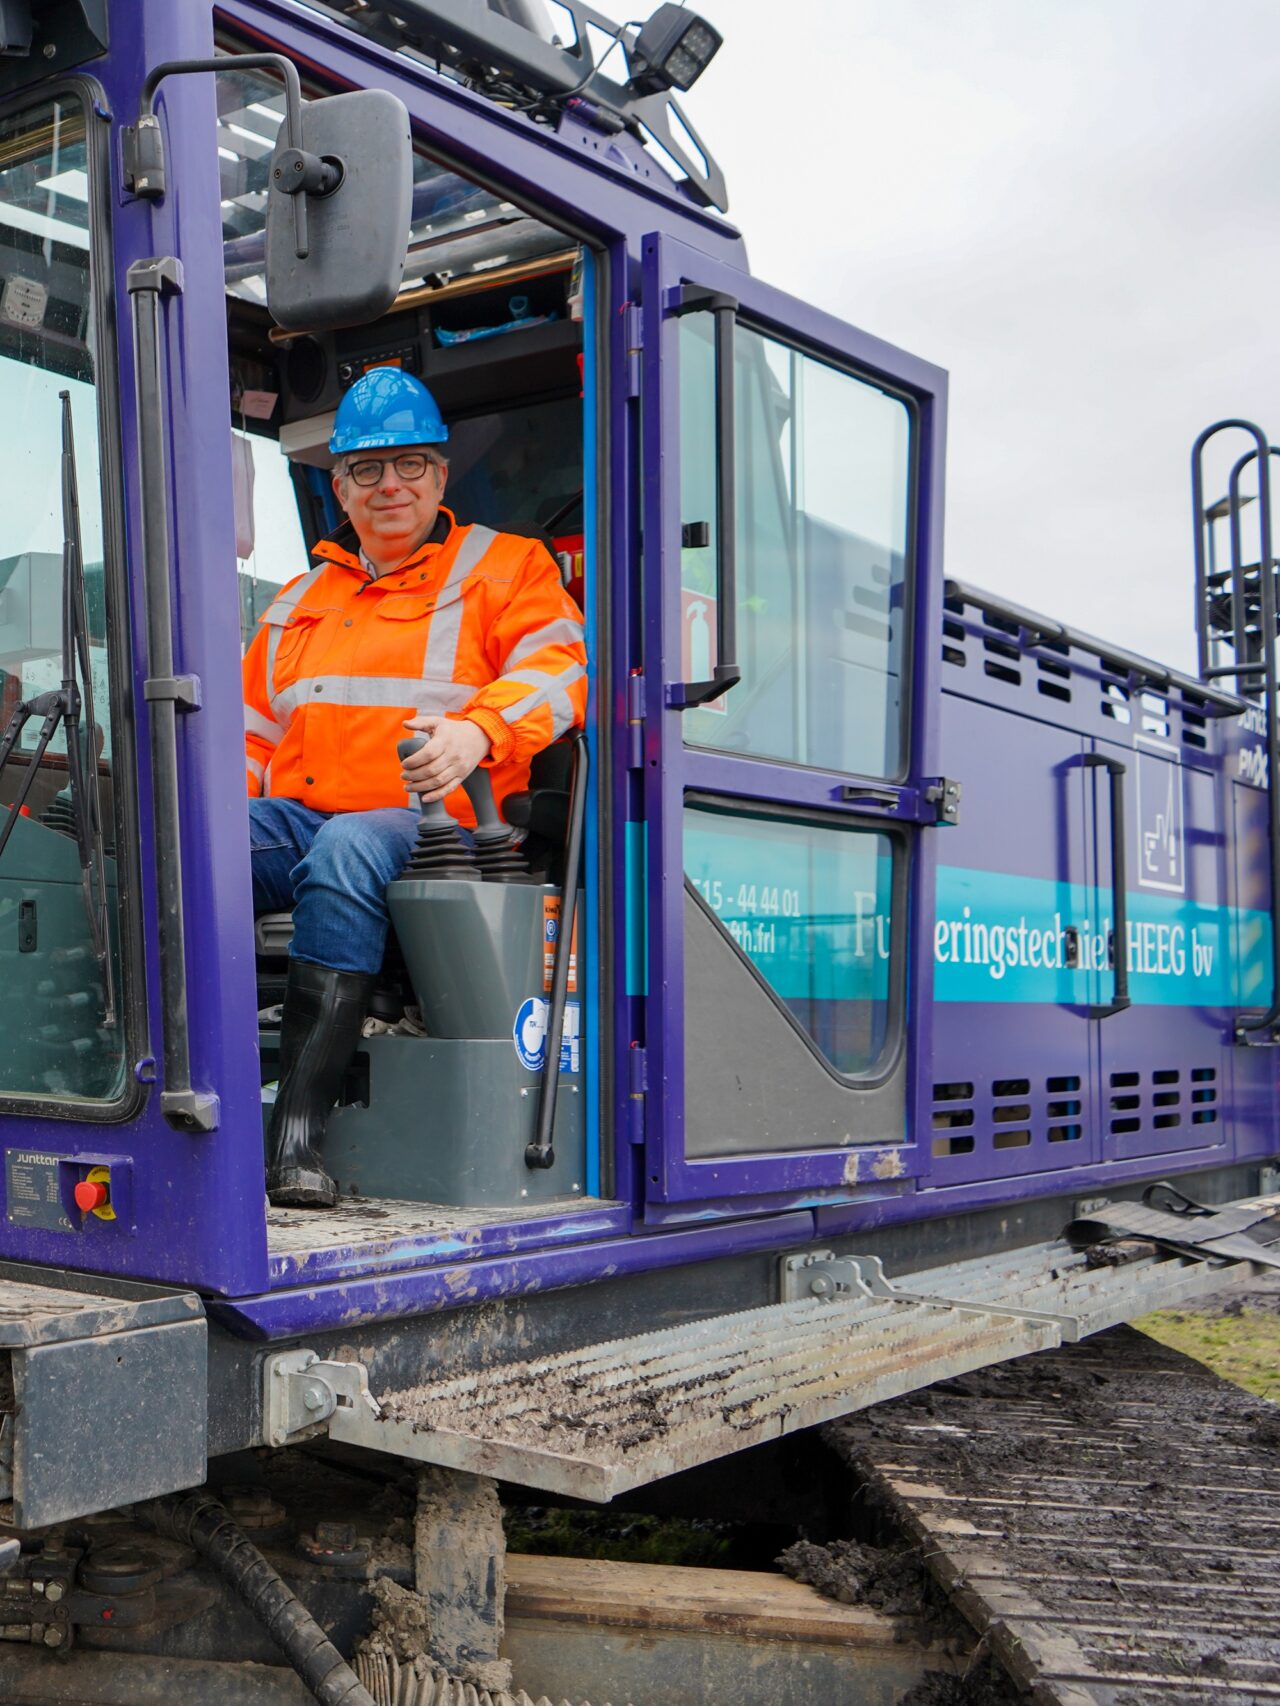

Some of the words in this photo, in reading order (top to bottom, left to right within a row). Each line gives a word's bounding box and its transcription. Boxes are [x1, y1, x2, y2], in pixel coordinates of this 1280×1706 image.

[1237, 707, 1268, 738] Juntt
[738, 883, 757, 913] 44
[761, 885, 779, 916] 44
[782, 888, 801, 918] 01
[721, 920, 775, 954] fth.frl
[1126, 920, 1186, 976] HEEG
[1191, 928, 1214, 977] bv
[17, 1154, 59, 1166] Junttan
